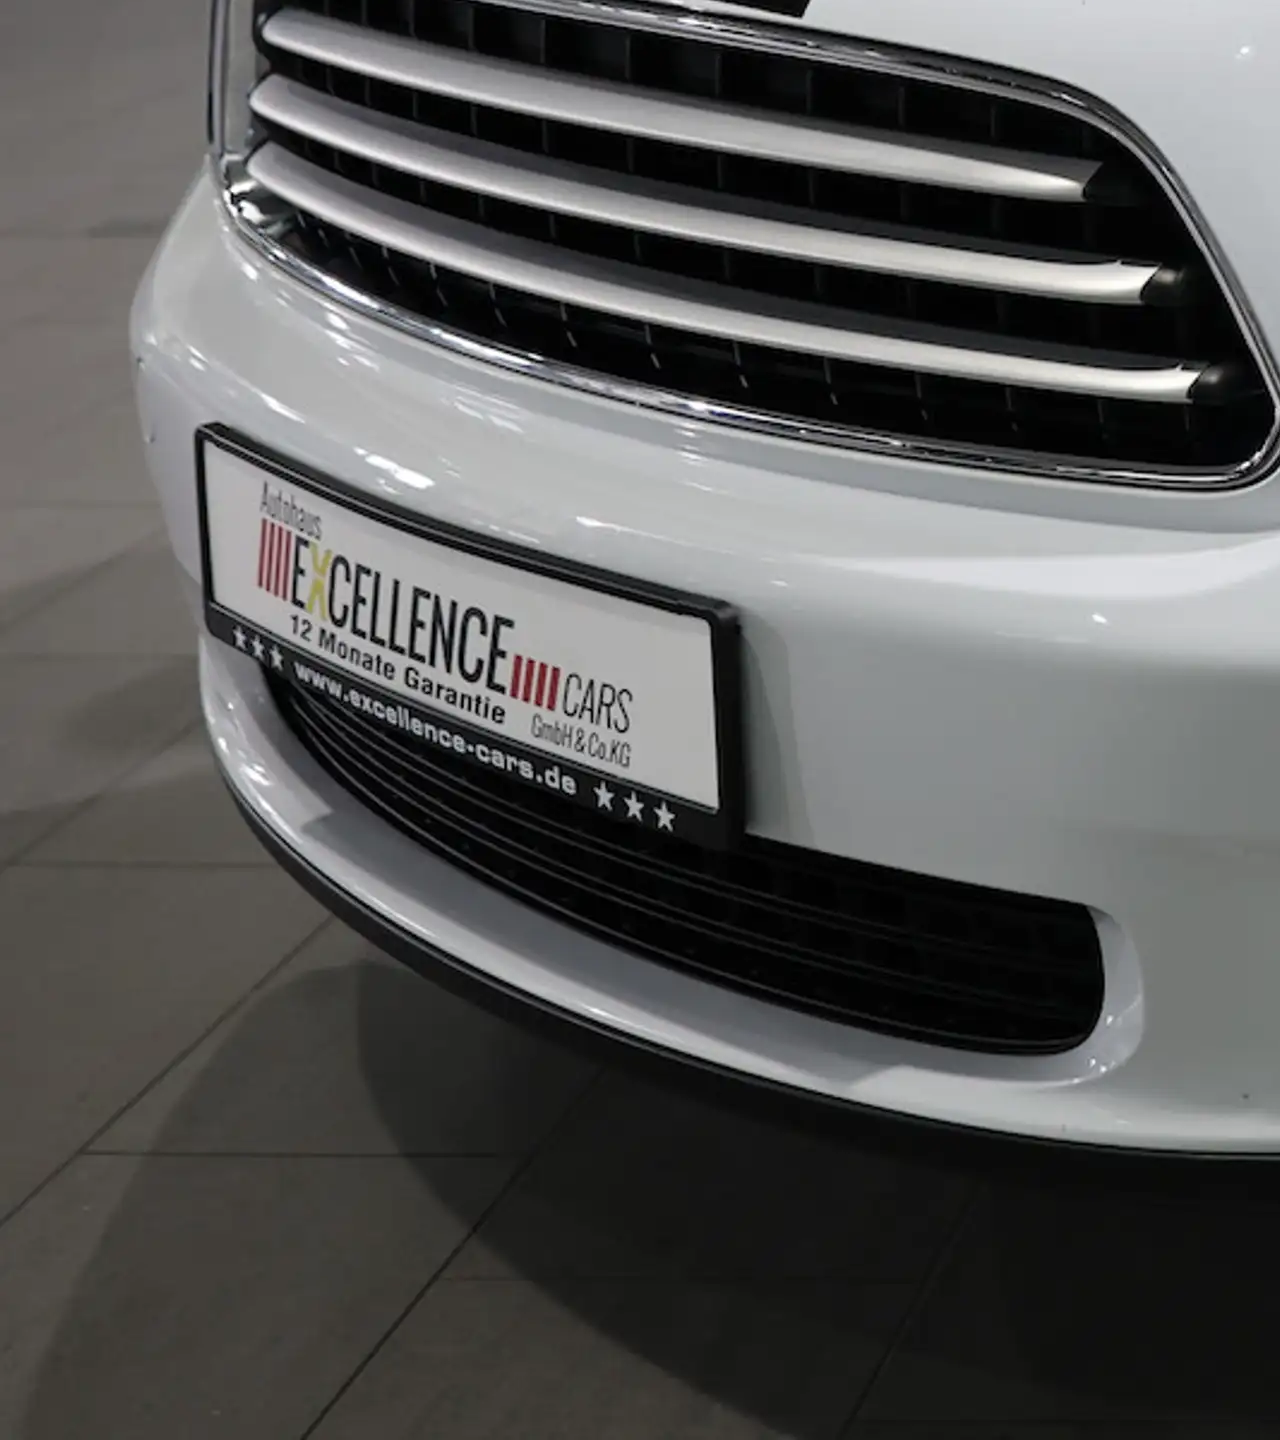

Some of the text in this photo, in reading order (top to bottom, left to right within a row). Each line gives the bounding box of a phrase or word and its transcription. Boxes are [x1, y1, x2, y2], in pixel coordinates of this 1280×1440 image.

[260, 480, 323, 541] Autohaus
[290, 614, 506, 725] 12 Monate Garantie
[291, 535, 633, 733] EXCELLENCE CARS
[294, 661, 577, 795] www.excellence-cars.de
